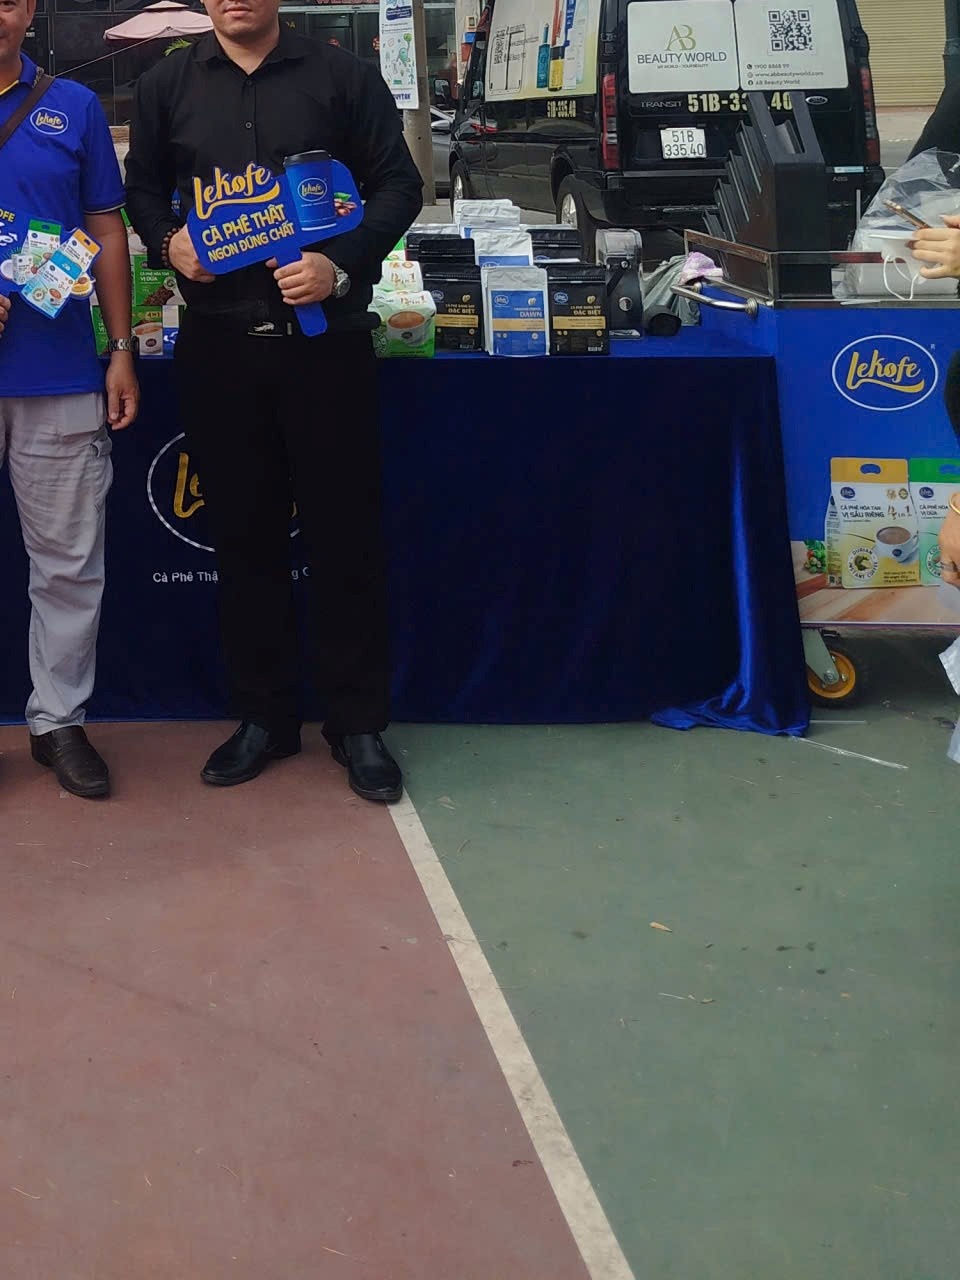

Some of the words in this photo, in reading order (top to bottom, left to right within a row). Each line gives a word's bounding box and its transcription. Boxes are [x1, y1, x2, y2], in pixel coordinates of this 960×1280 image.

[637, 53, 682, 64] BEAUTY
[684, 51, 727, 63] WORLD
[640, 100, 682, 108] TRANSIT
[687, 91, 793, 113] 51B-3.40
[672, 130, 695, 143] 51B
[665, 143, 704, 157] 335.40
[224, 215, 253, 240] PHÊ
[207, 241, 239, 263] NGON
[152, 572, 168, 583] Cà
[172, 571, 193, 583] Phê
[197, 570, 218, 584] Thậ
